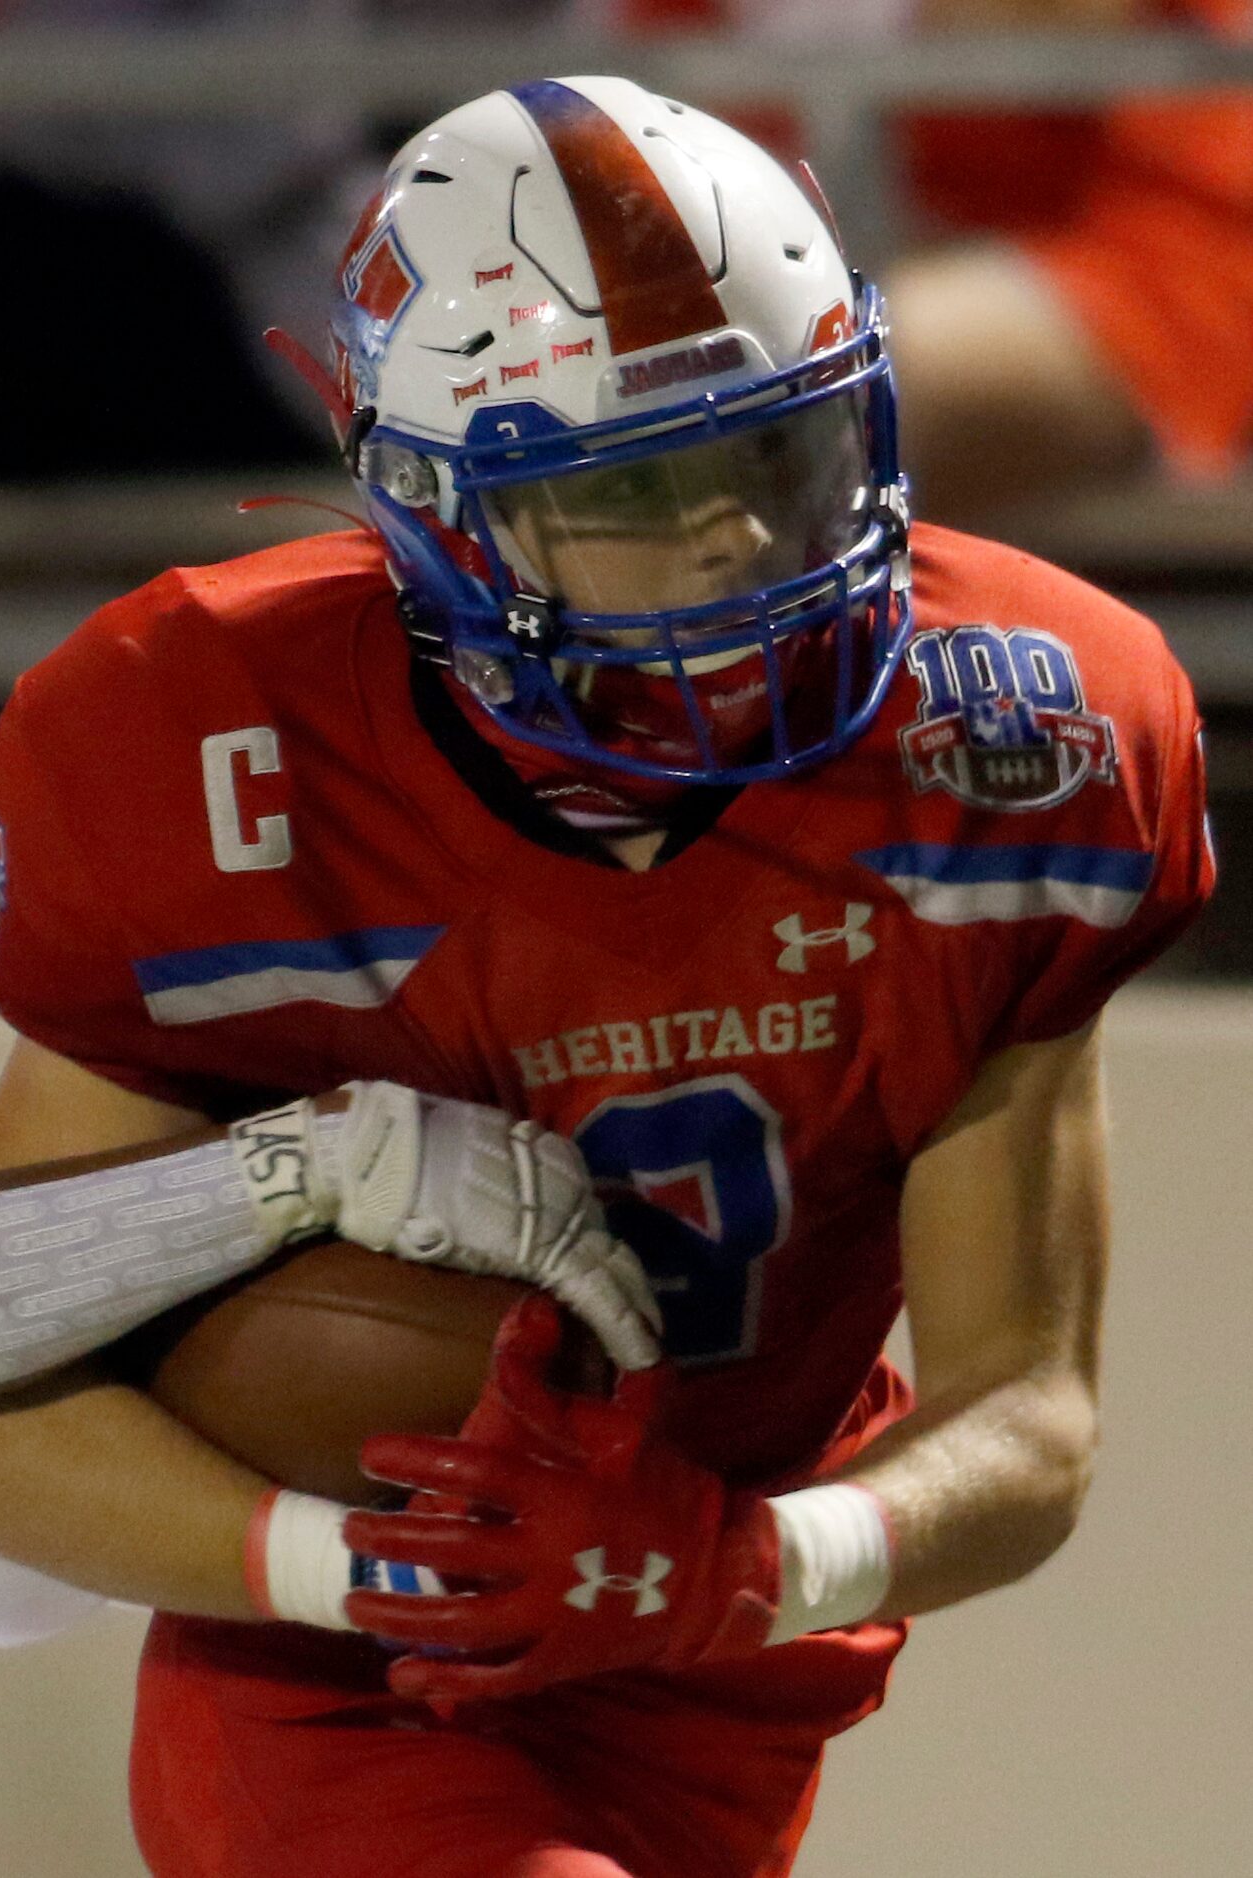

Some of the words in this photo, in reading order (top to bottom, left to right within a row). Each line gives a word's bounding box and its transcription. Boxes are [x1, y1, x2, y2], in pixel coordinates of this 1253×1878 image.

[905, 622, 1085, 722] 100
[202, 727, 292, 872] C
[512, 995, 838, 1088] HERITAGE
